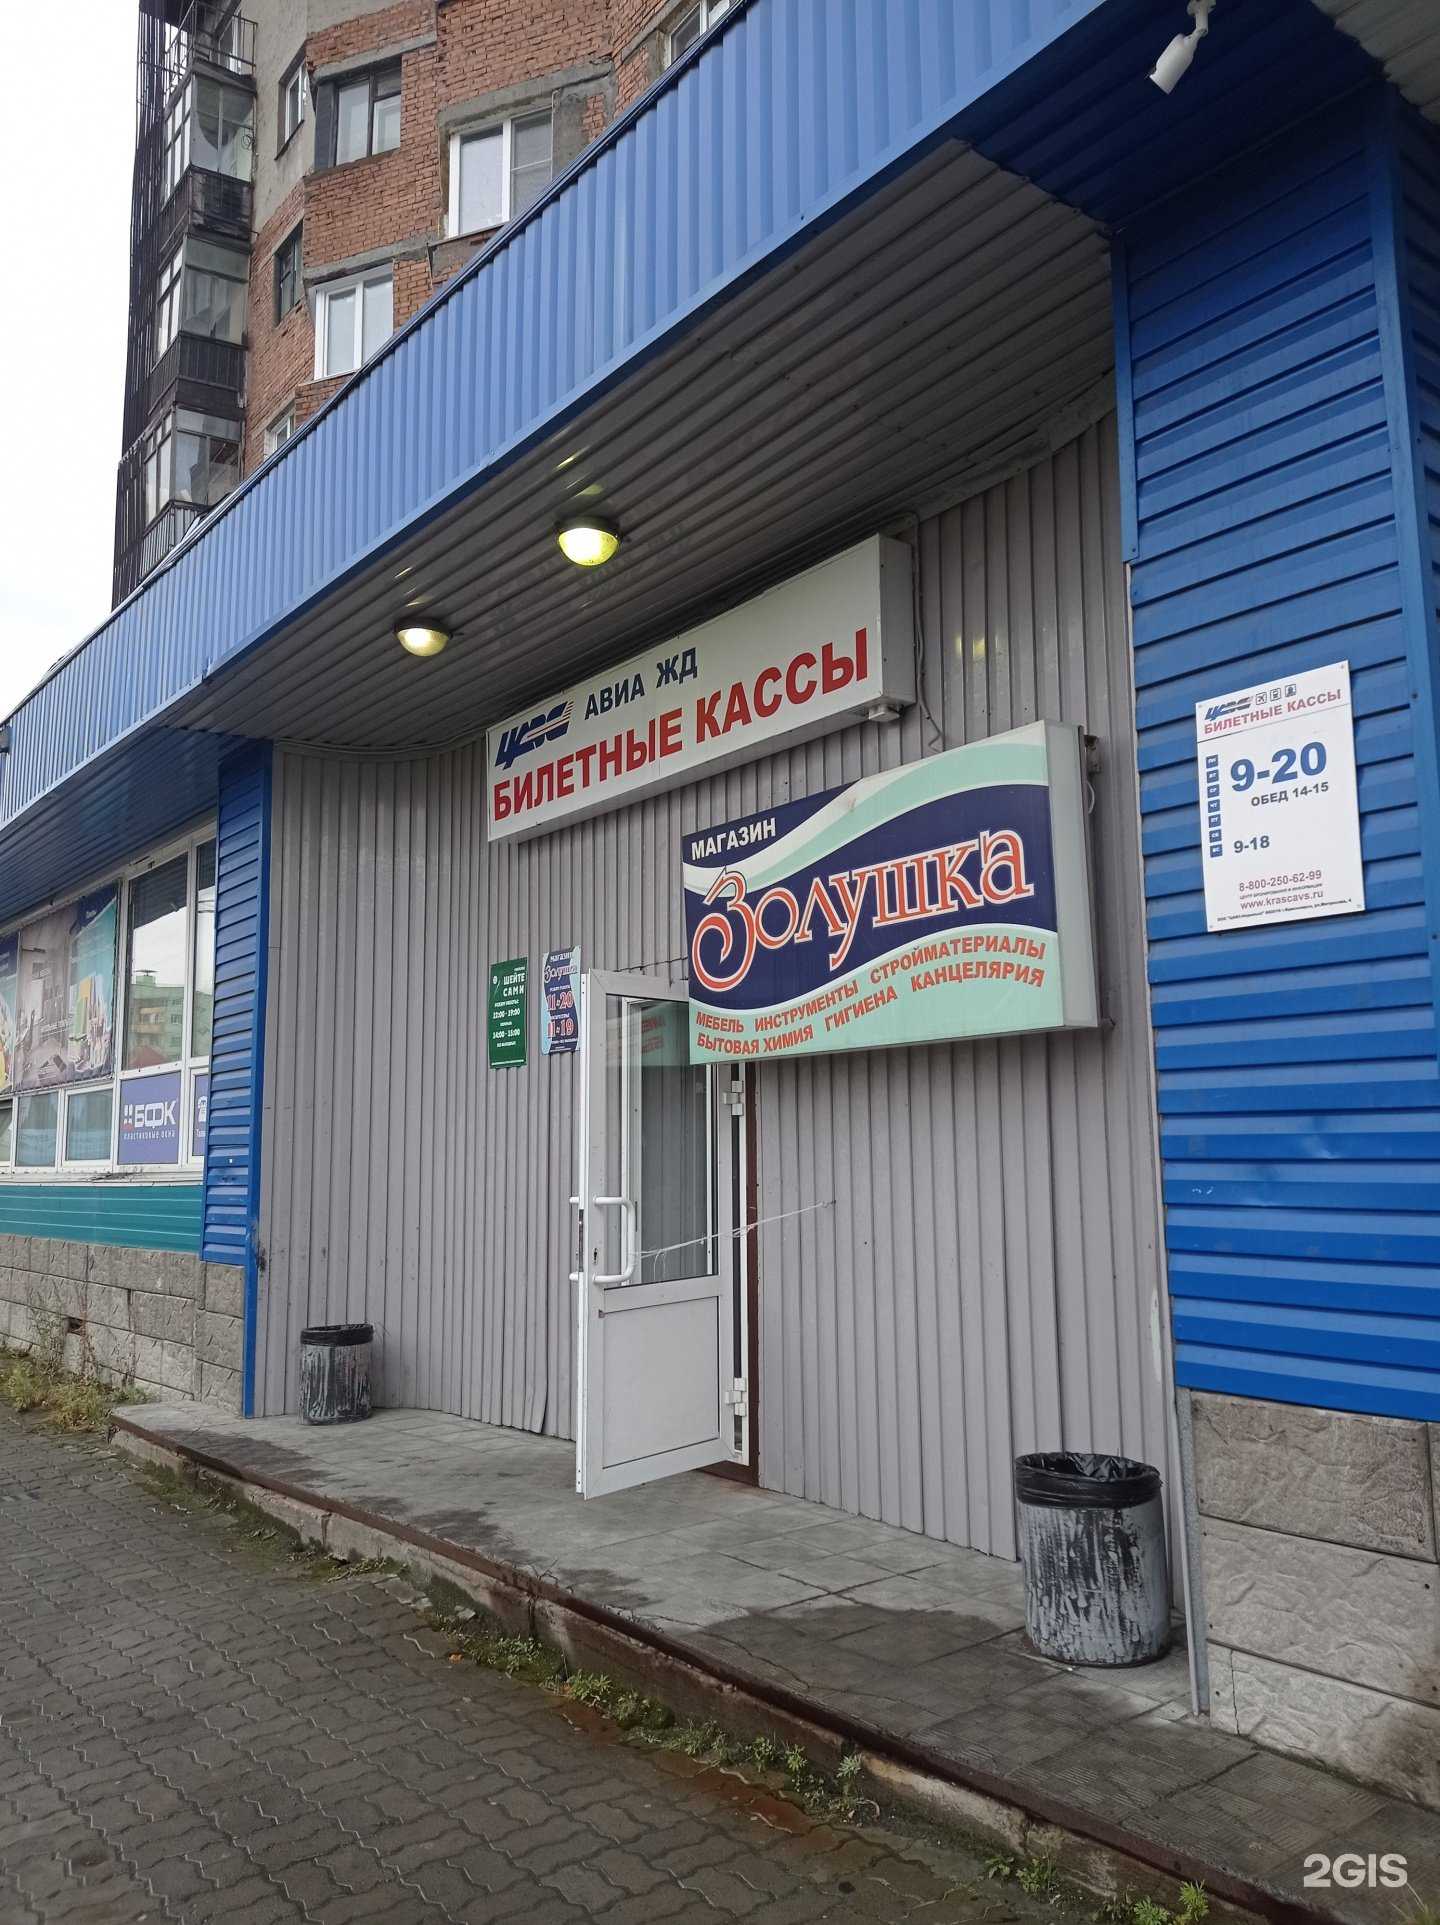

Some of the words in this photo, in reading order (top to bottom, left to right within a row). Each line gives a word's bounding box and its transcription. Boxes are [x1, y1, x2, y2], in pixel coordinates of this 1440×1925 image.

[585, 673, 645, 720] АВИА
[656, 647, 698, 689] ЖД
[494, 707, 683, 822] БИЛЕТНЫЕ
[696, 627, 869, 744] КАССЫ
[1204, 704, 1283, 734] БИЛЕТНЫЕ
[1287, 689, 1342, 713] КАССЫ
[1230, 741, 1327, 792] 9-20
[1251, 790, 1288, 807] ОБЕД
[1292, 782, 1329, 799] 14-15
[692, 818, 776, 860] МАГАЗИН
[1234, 835, 1270, 853] 9-18
[1239, 870, 1322, 892] 8-800-250-62-99
[1240, 890, 1324, 910] www.krascavs.ru
[692, 828, 1035, 992] Золушка
[503, 985, 525, 997] САМИ
[696, 1011, 744, 1033] МЕБЕЛЬ
[755, 979, 859, 1033] ИНСТРУМЕНТЫ
[870, 935, 1046, 985] СТРОЙМАТЕРИАЛЫ
[697, 1032, 759, 1055] БЫТОВАЯ
[763, 1023, 813, 1053] ХИМИЯ
[824, 985, 898, 1032] ГИГИЕНА
[911, 961, 1045, 993] КАНЦЕЛЯРИЯ
